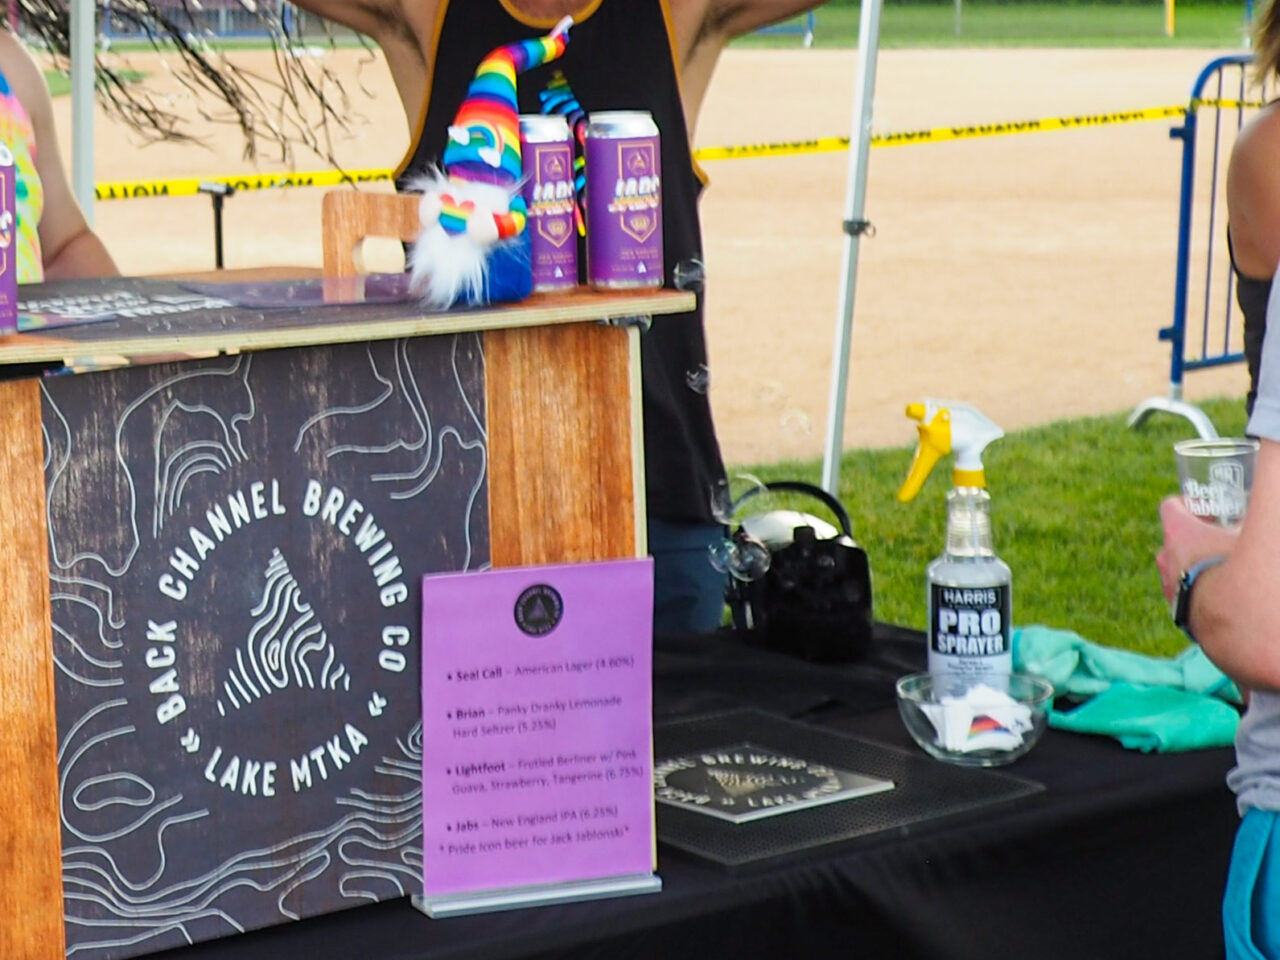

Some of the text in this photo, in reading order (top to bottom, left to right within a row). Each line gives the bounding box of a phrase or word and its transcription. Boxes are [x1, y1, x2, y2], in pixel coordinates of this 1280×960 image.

[145, 478, 411, 725] BACK CHANNEL BREWING CO
[943, 589, 997, 605] HARRIS
[938, 608, 1002, 636] PRO
[936, 633, 1004, 656] SPRAYER
[456, 669, 479, 682] Seal
[482, 666, 503, 680] Call
[514, 663, 564, 677] American
[565, 659, 593, 674] Lager
[456, 709, 486, 721] Brian
[531, 700, 566, 714] Dranky
[569, 695, 622, 710] Lemonade
[453, 726, 478, 739] Hard
[481, 722, 515, 737] Seltzer
[204, 723, 369, 797] LAKE MTKA
[455, 762, 506, 779] Lightfoot
[556, 753, 597, 767] Berliner
[615, 749, 637, 761] Pink
[553, 770, 603, 786] Tangerine
[456, 821, 479, 833] Jabs
[491, 817, 515, 829] New
[517, 813, 558, 827] England
[560, 809, 577, 821] IPA
[504, 837, 529, 850] beer
[532, 834, 549, 847] for
